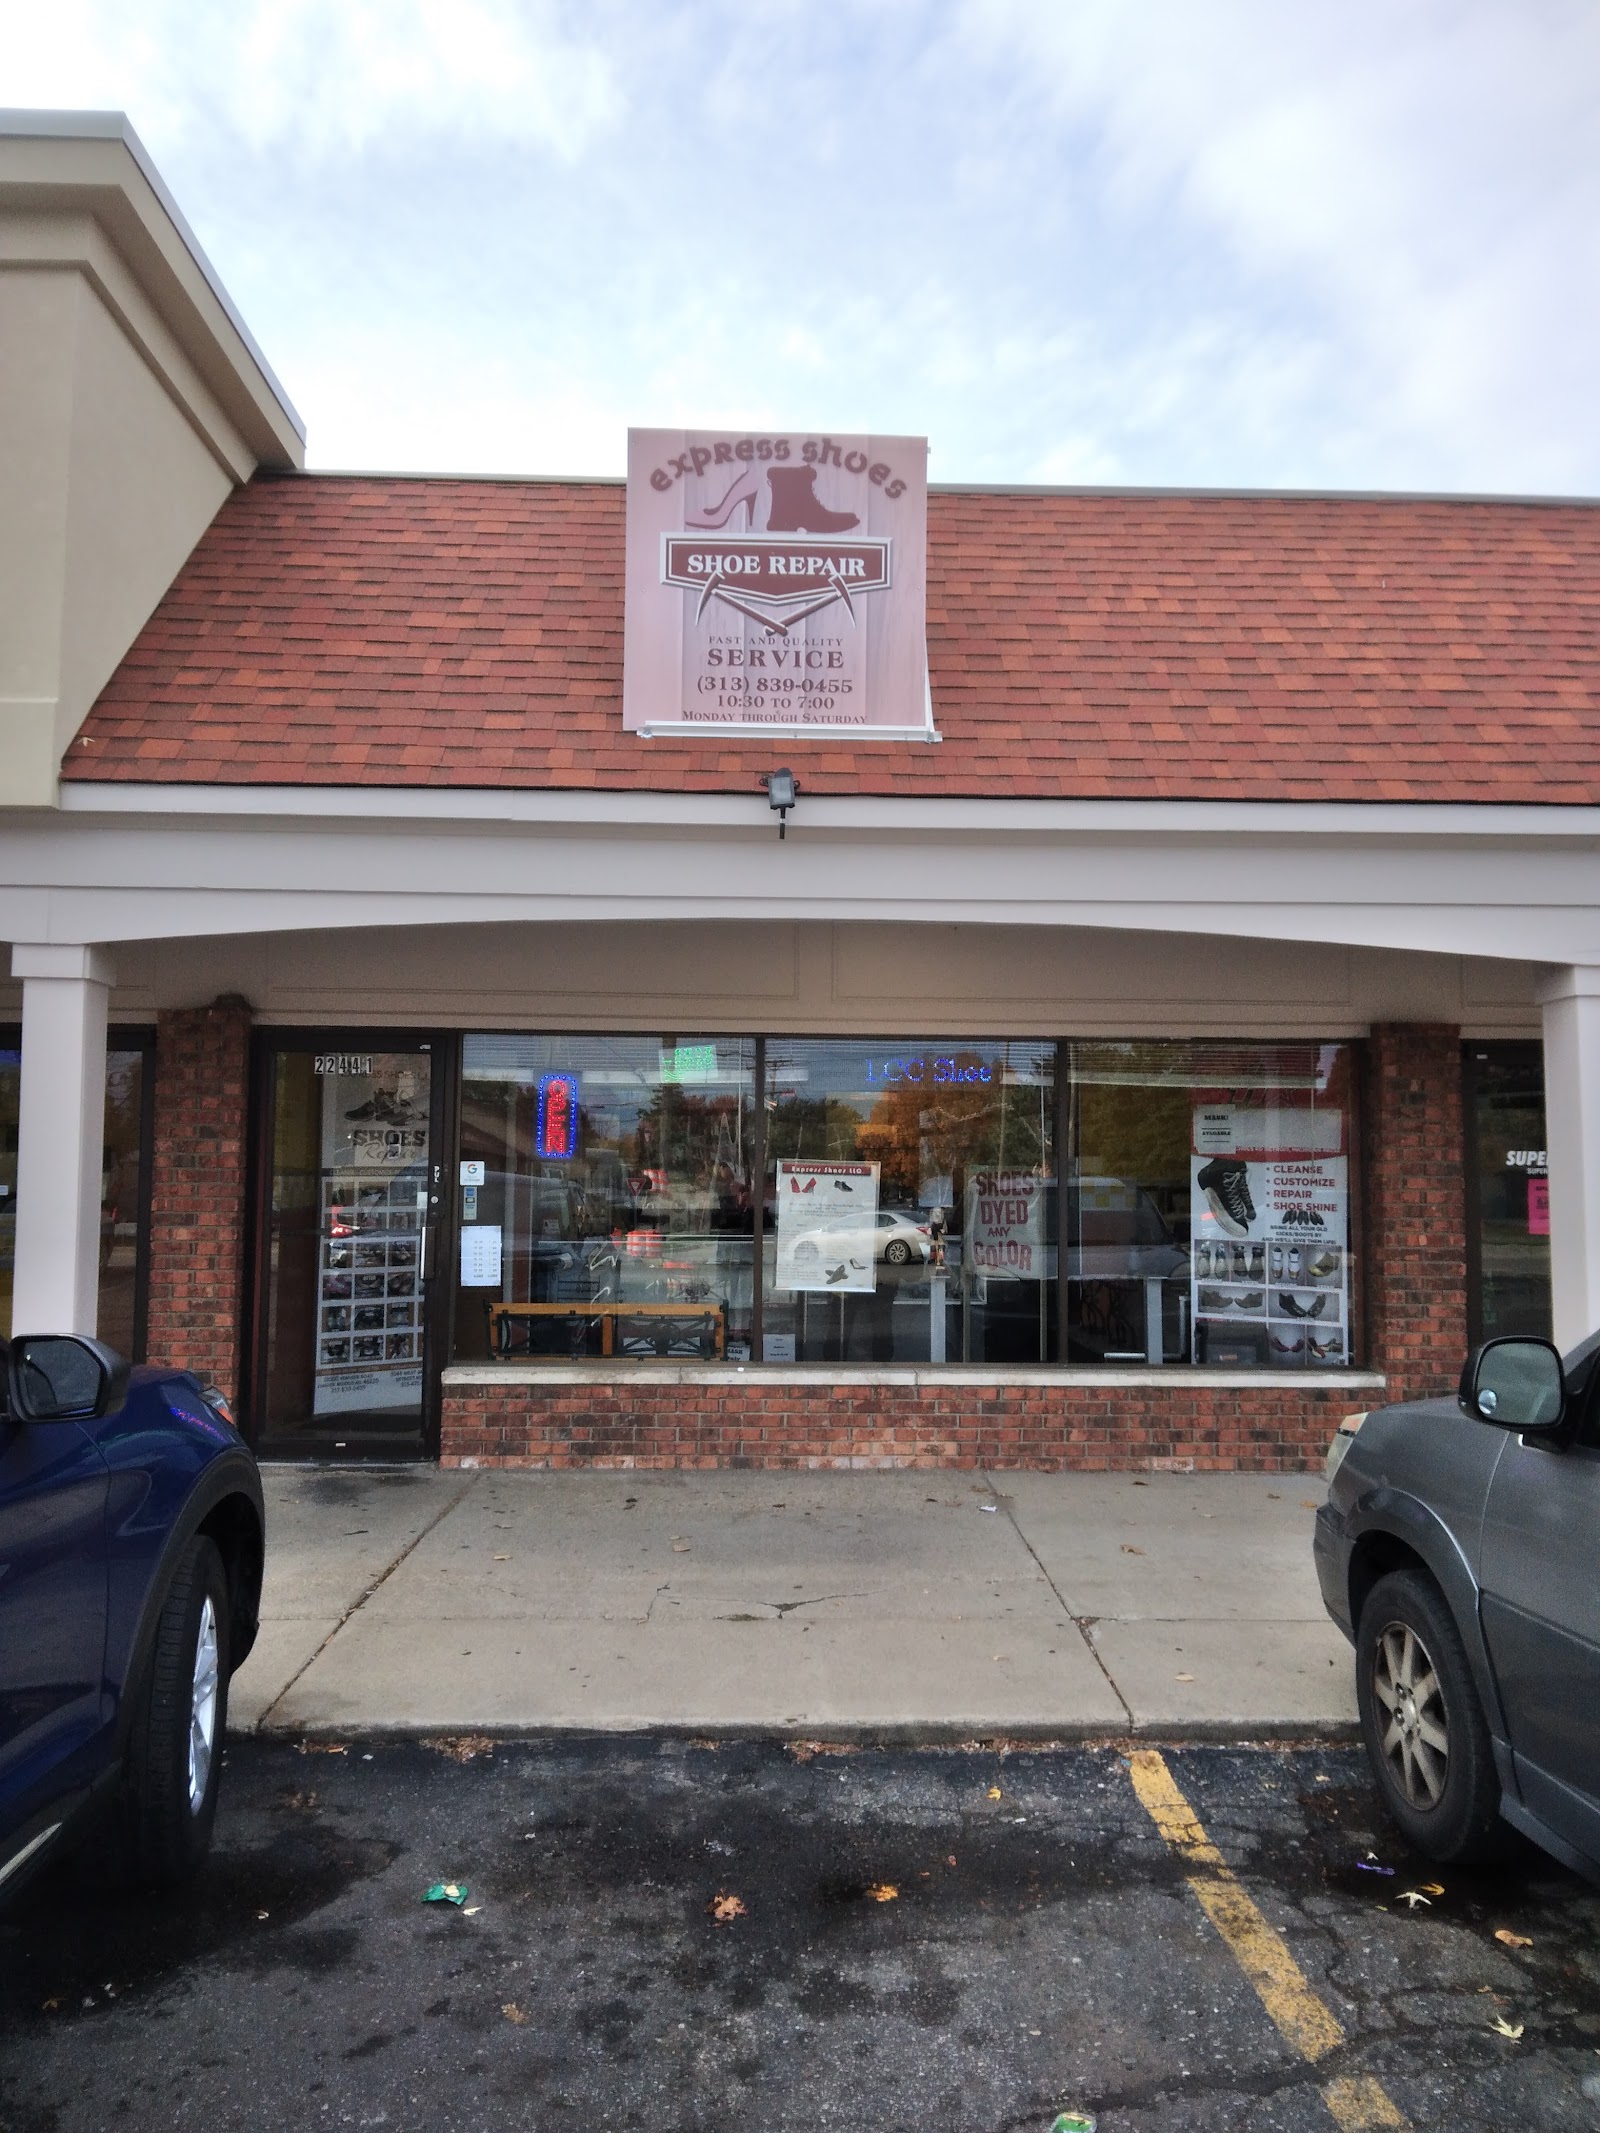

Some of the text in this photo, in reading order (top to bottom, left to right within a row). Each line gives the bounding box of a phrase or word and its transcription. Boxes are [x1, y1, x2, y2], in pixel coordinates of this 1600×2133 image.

[650, 438, 907, 498] express shoes
[687, 554, 866, 577] SHOE REPAIR
[709, 636, 844, 646] FAST AND QUALITY
[707, 649, 844, 669] SERVICE
[697, 676, 853, 694] (313) 839-0455
[717, 695, 834, 709] 10:30 TO 7:00
[682, 711, 867, 724] MONDAY THROUGH SATURDAY
[316, 1057, 372, 1073] 22441
[934, 1058, 991, 1082] Shoe
[546, 1080, 567, 1153] OPEN
[353, 1130, 426, 1147] SHOES
[1273, 1165, 1323, 1174] CLEANSE
[976, 1171, 1034, 1196] SHOES
[1273, 1177, 1335, 1187] CUSTOMIZE
[1273, 1190, 1313, 1198] REPAIR
[981, 1200, 1029, 1224] DYED
[1273, 1202, 1338, 1211] SHOE SHINE
[988, 1226, 1011, 1237] ANY
[974, 1240, 1032, 1271] COLOR
